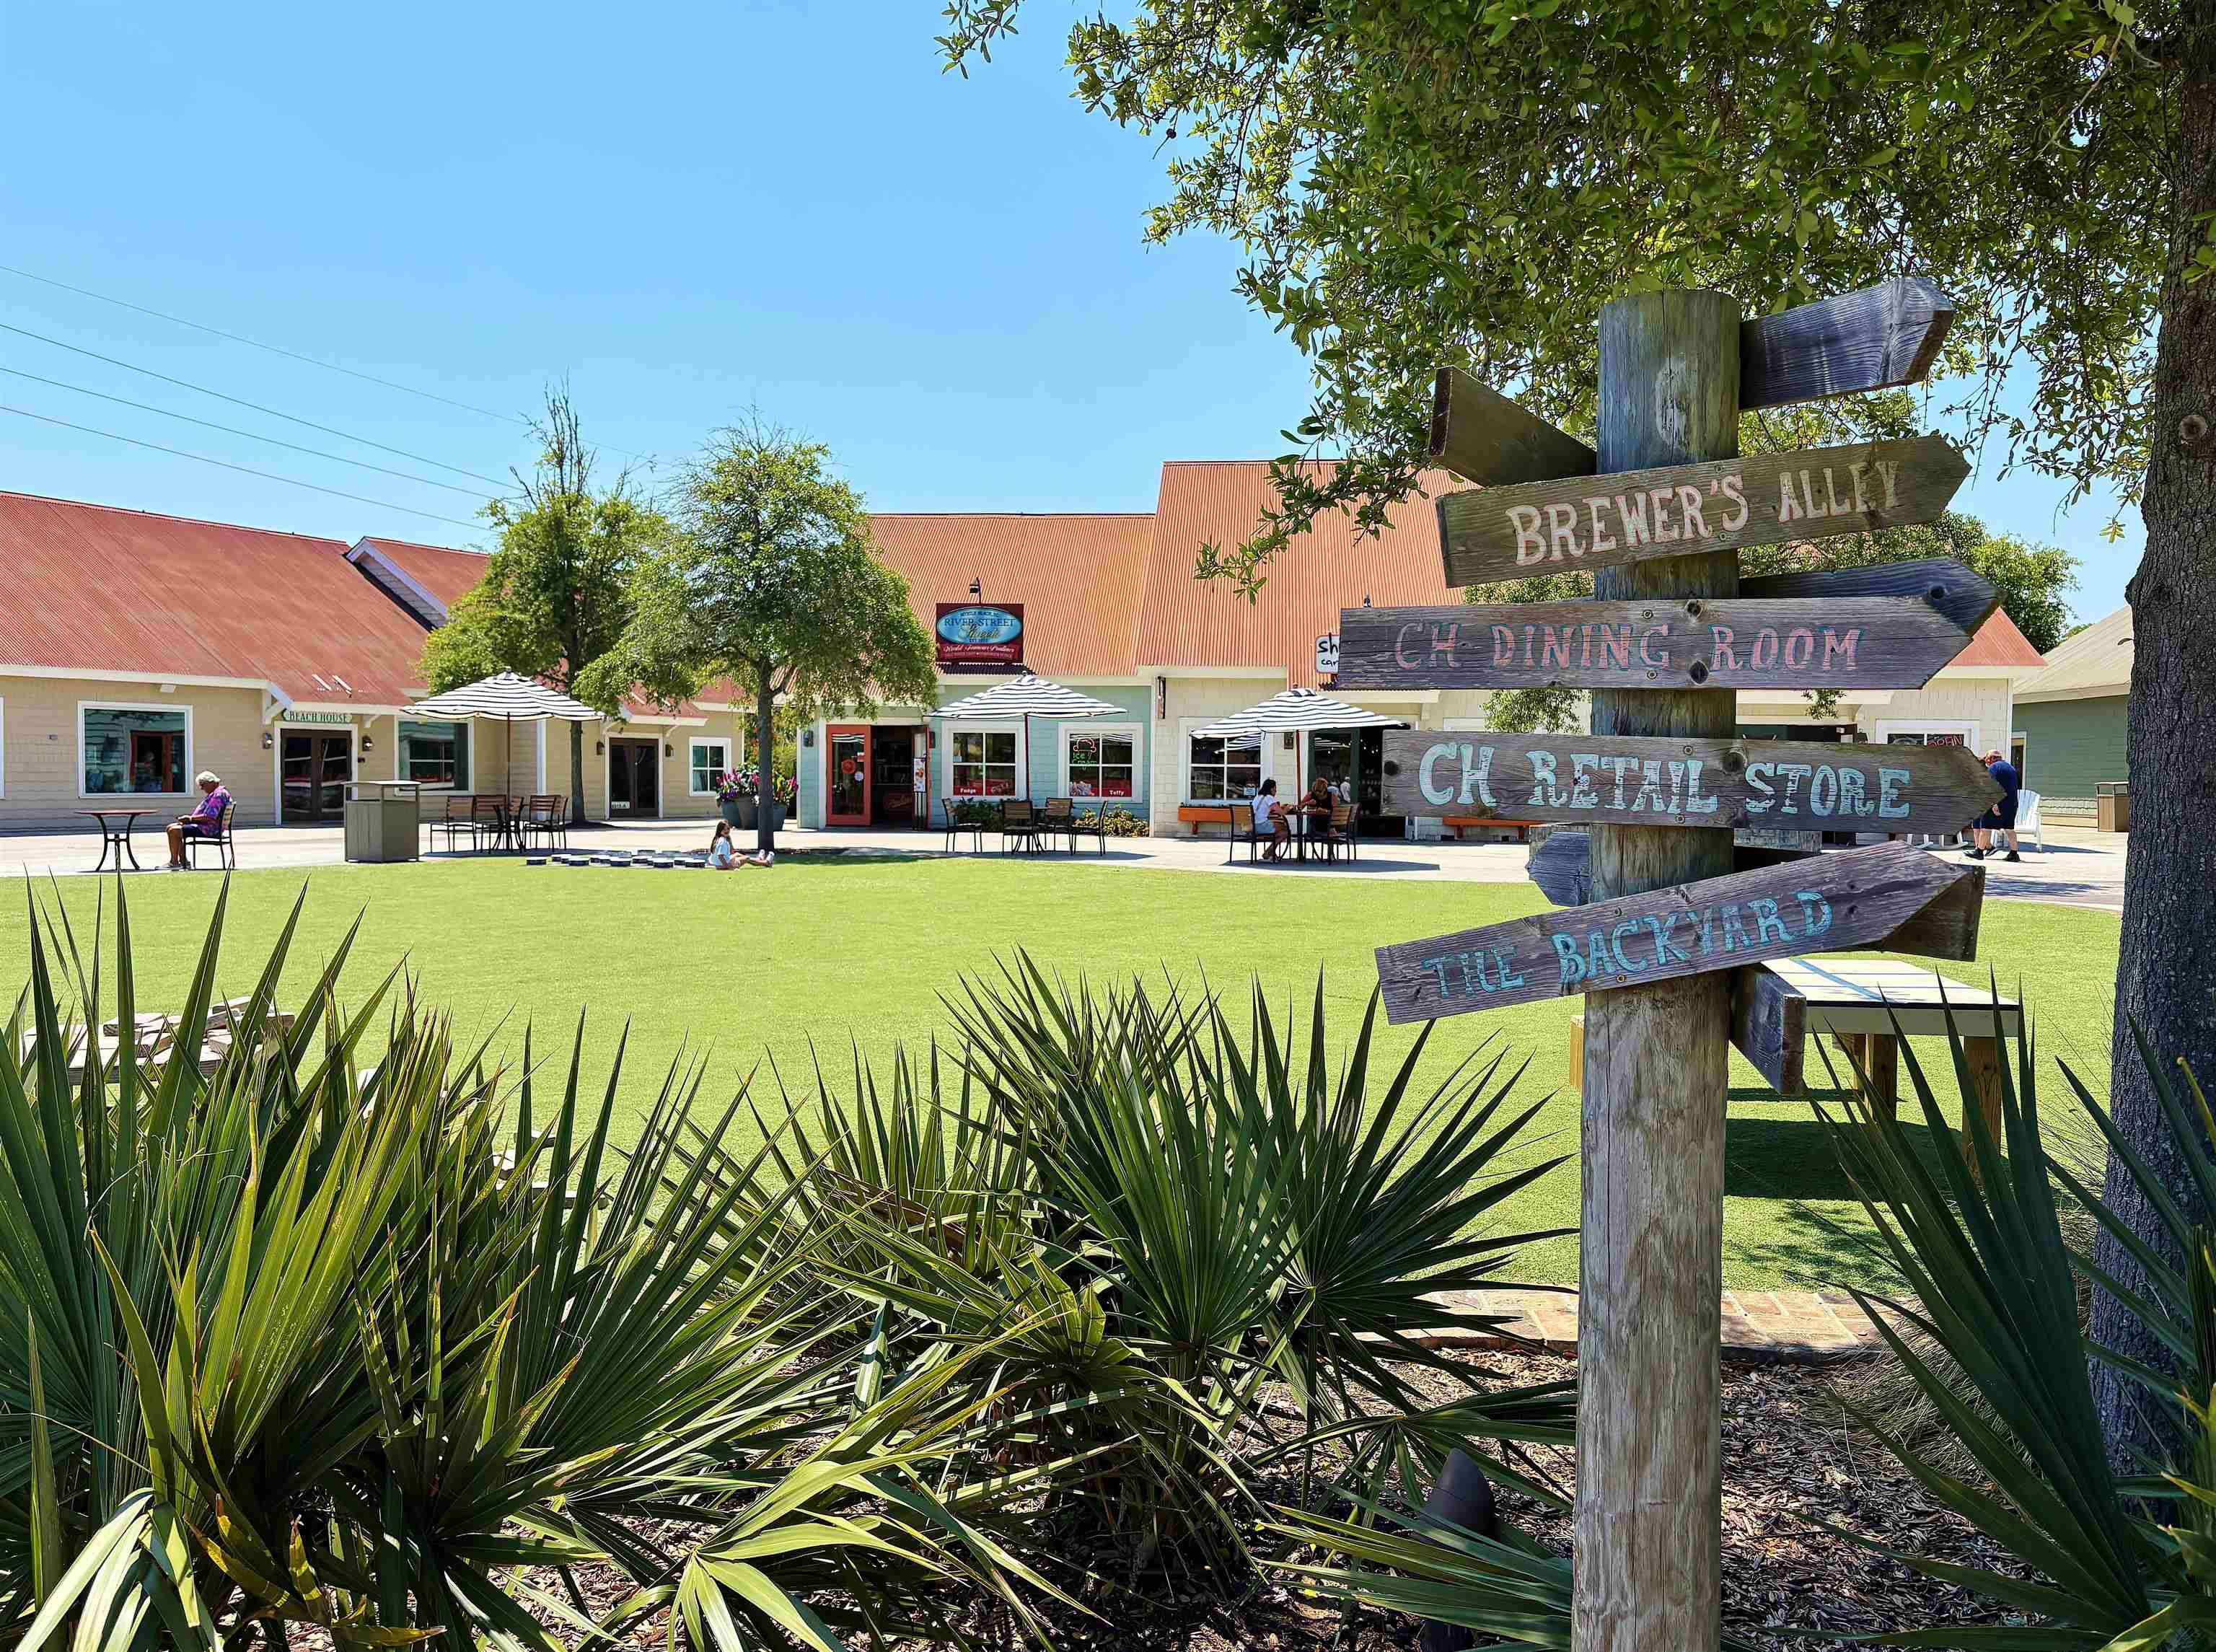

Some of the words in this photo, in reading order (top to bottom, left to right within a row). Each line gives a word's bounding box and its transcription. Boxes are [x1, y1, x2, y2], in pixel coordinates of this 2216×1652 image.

[1505, 474, 1749, 567] BREWER'S
[1777, 460, 1900, 524] ALLEY
[945, 618, 974, 627] RIVER
[977, 618, 1016, 627] STREET
[1395, 622, 1459, 671] CH
[1491, 623, 1671, 672] DINING
[1711, 625, 1863, 672] ROOM
[289, 711, 317, 722] BEACH
[320, 711, 348, 722] HOUSE
[1419, 742, 1500, 808] CH
[1526, 750, 1719, 814] RETAIL
[1744, 762, 1912, 819] STORE
[1423, 946, 1526, 998] THE
[1550, 890, 1834, 986] BACKYARD
